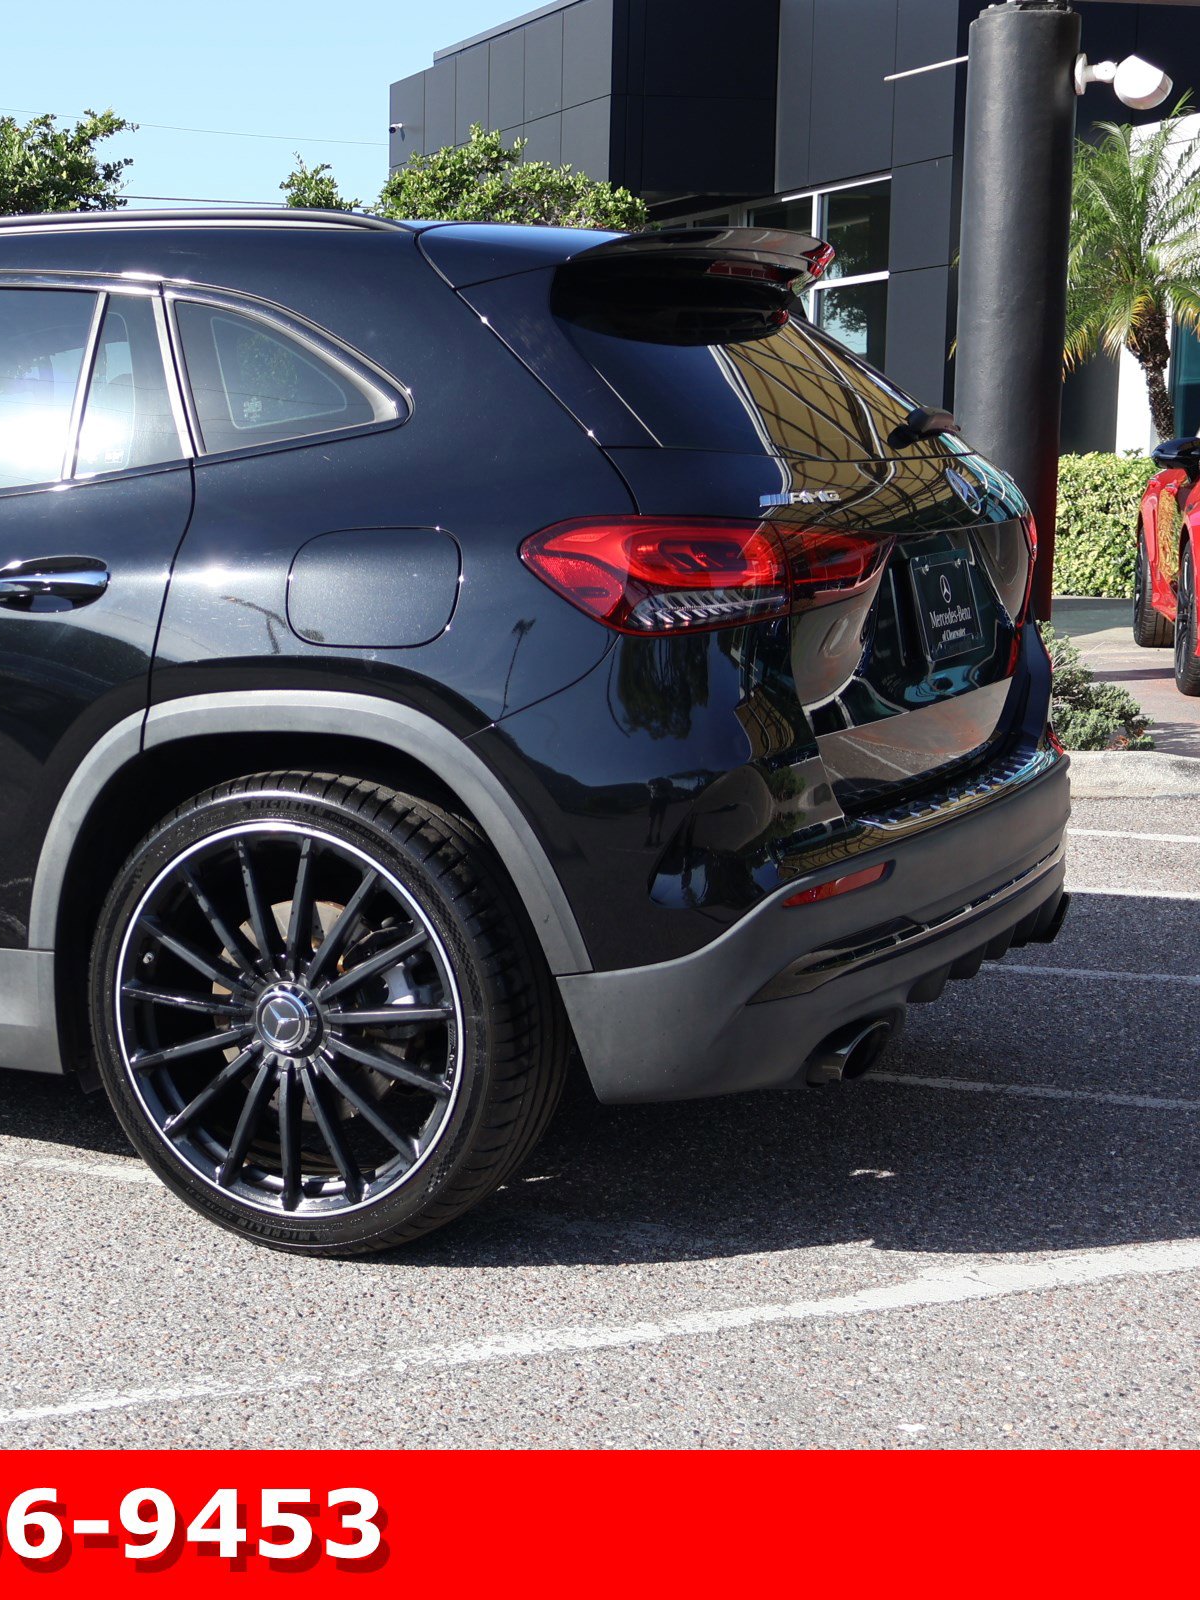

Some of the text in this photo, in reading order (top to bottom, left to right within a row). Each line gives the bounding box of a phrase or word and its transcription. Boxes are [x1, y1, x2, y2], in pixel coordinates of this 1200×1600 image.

[790, 490, 841, 504] AMG
[929, 605, 972, 629] Mercedes-Benz
[251, 799, 327, 817] MICHELIN
[237, 1219, 310, 1241] MICHELIN
